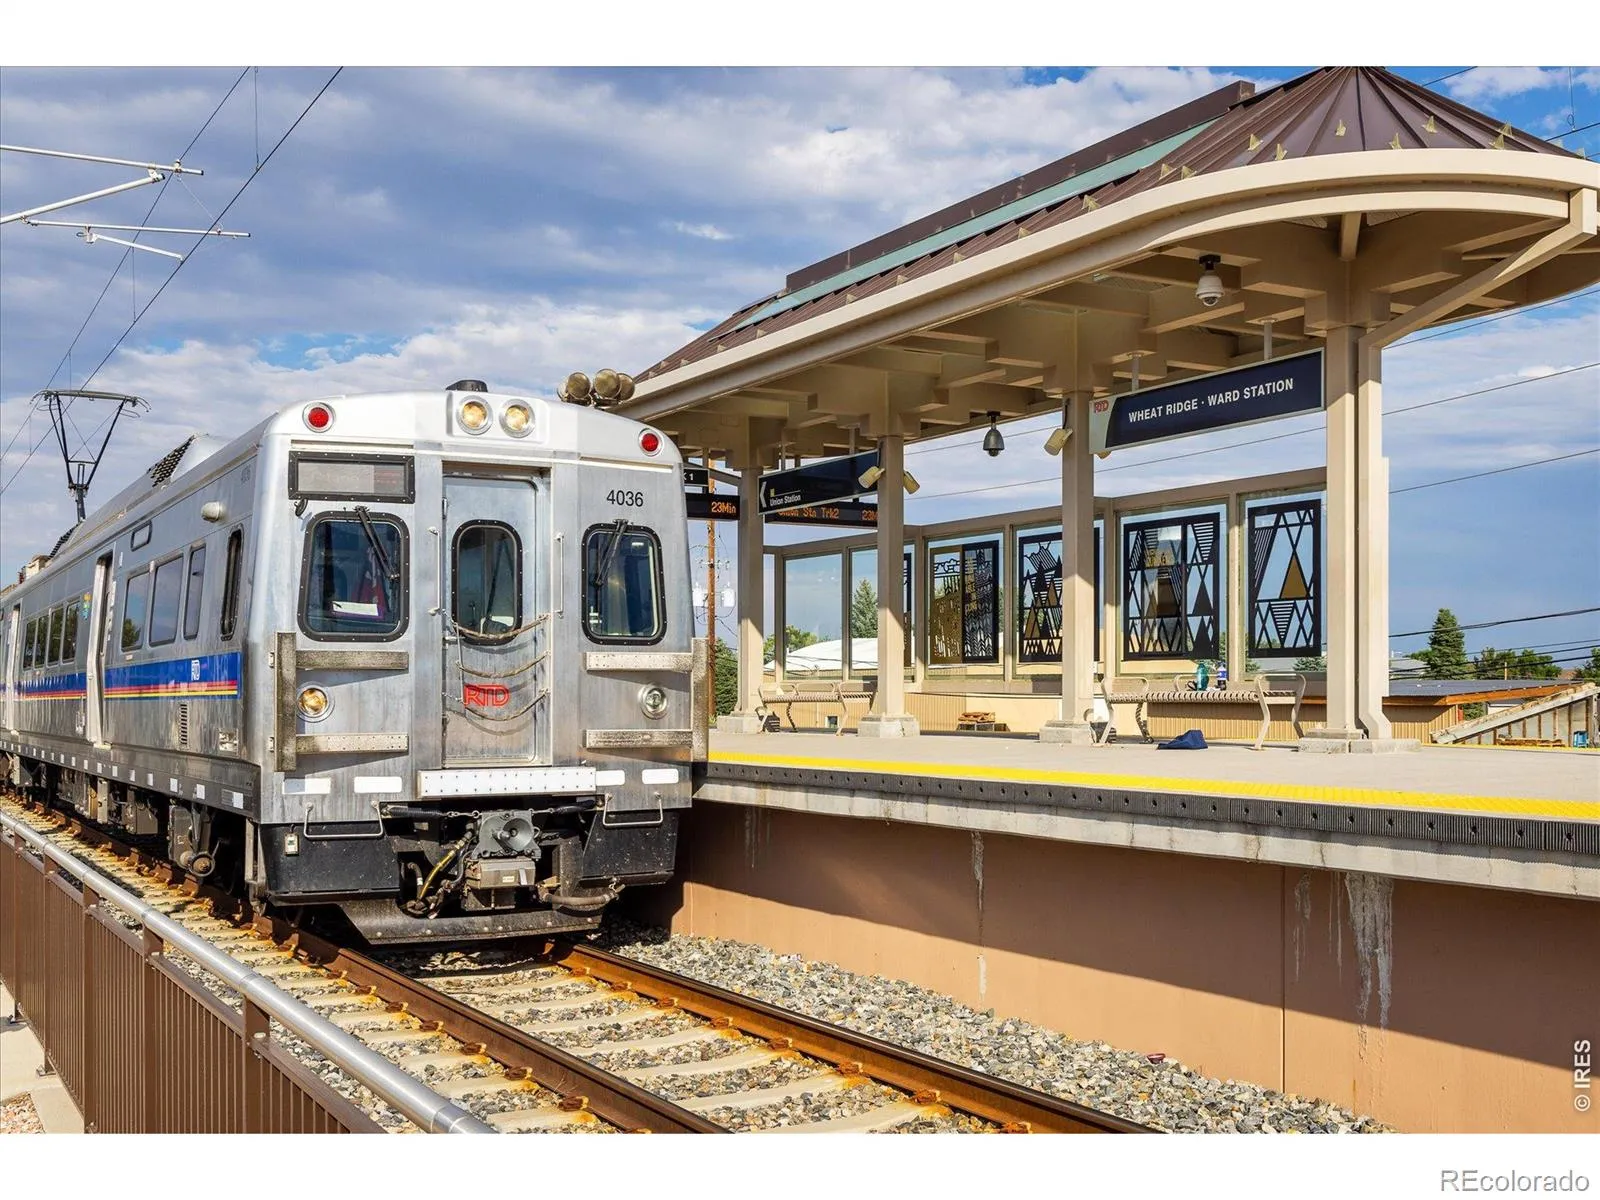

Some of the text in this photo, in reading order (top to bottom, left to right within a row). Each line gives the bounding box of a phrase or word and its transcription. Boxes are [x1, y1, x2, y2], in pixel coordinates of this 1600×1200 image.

[1128, 406, 1164, 422] WHEAT
[1166, 399, 1198, 415] RIDGE
[1207, 389, 1240, 407] WARD
[1243, 377, 1294, 399] STATION
[606, 490, 643, 508] 4036
[711, 501, 737, 514] 23Min
[769, 493, 801, 507] Union Station
[463, 684, 510, 707] RTD
